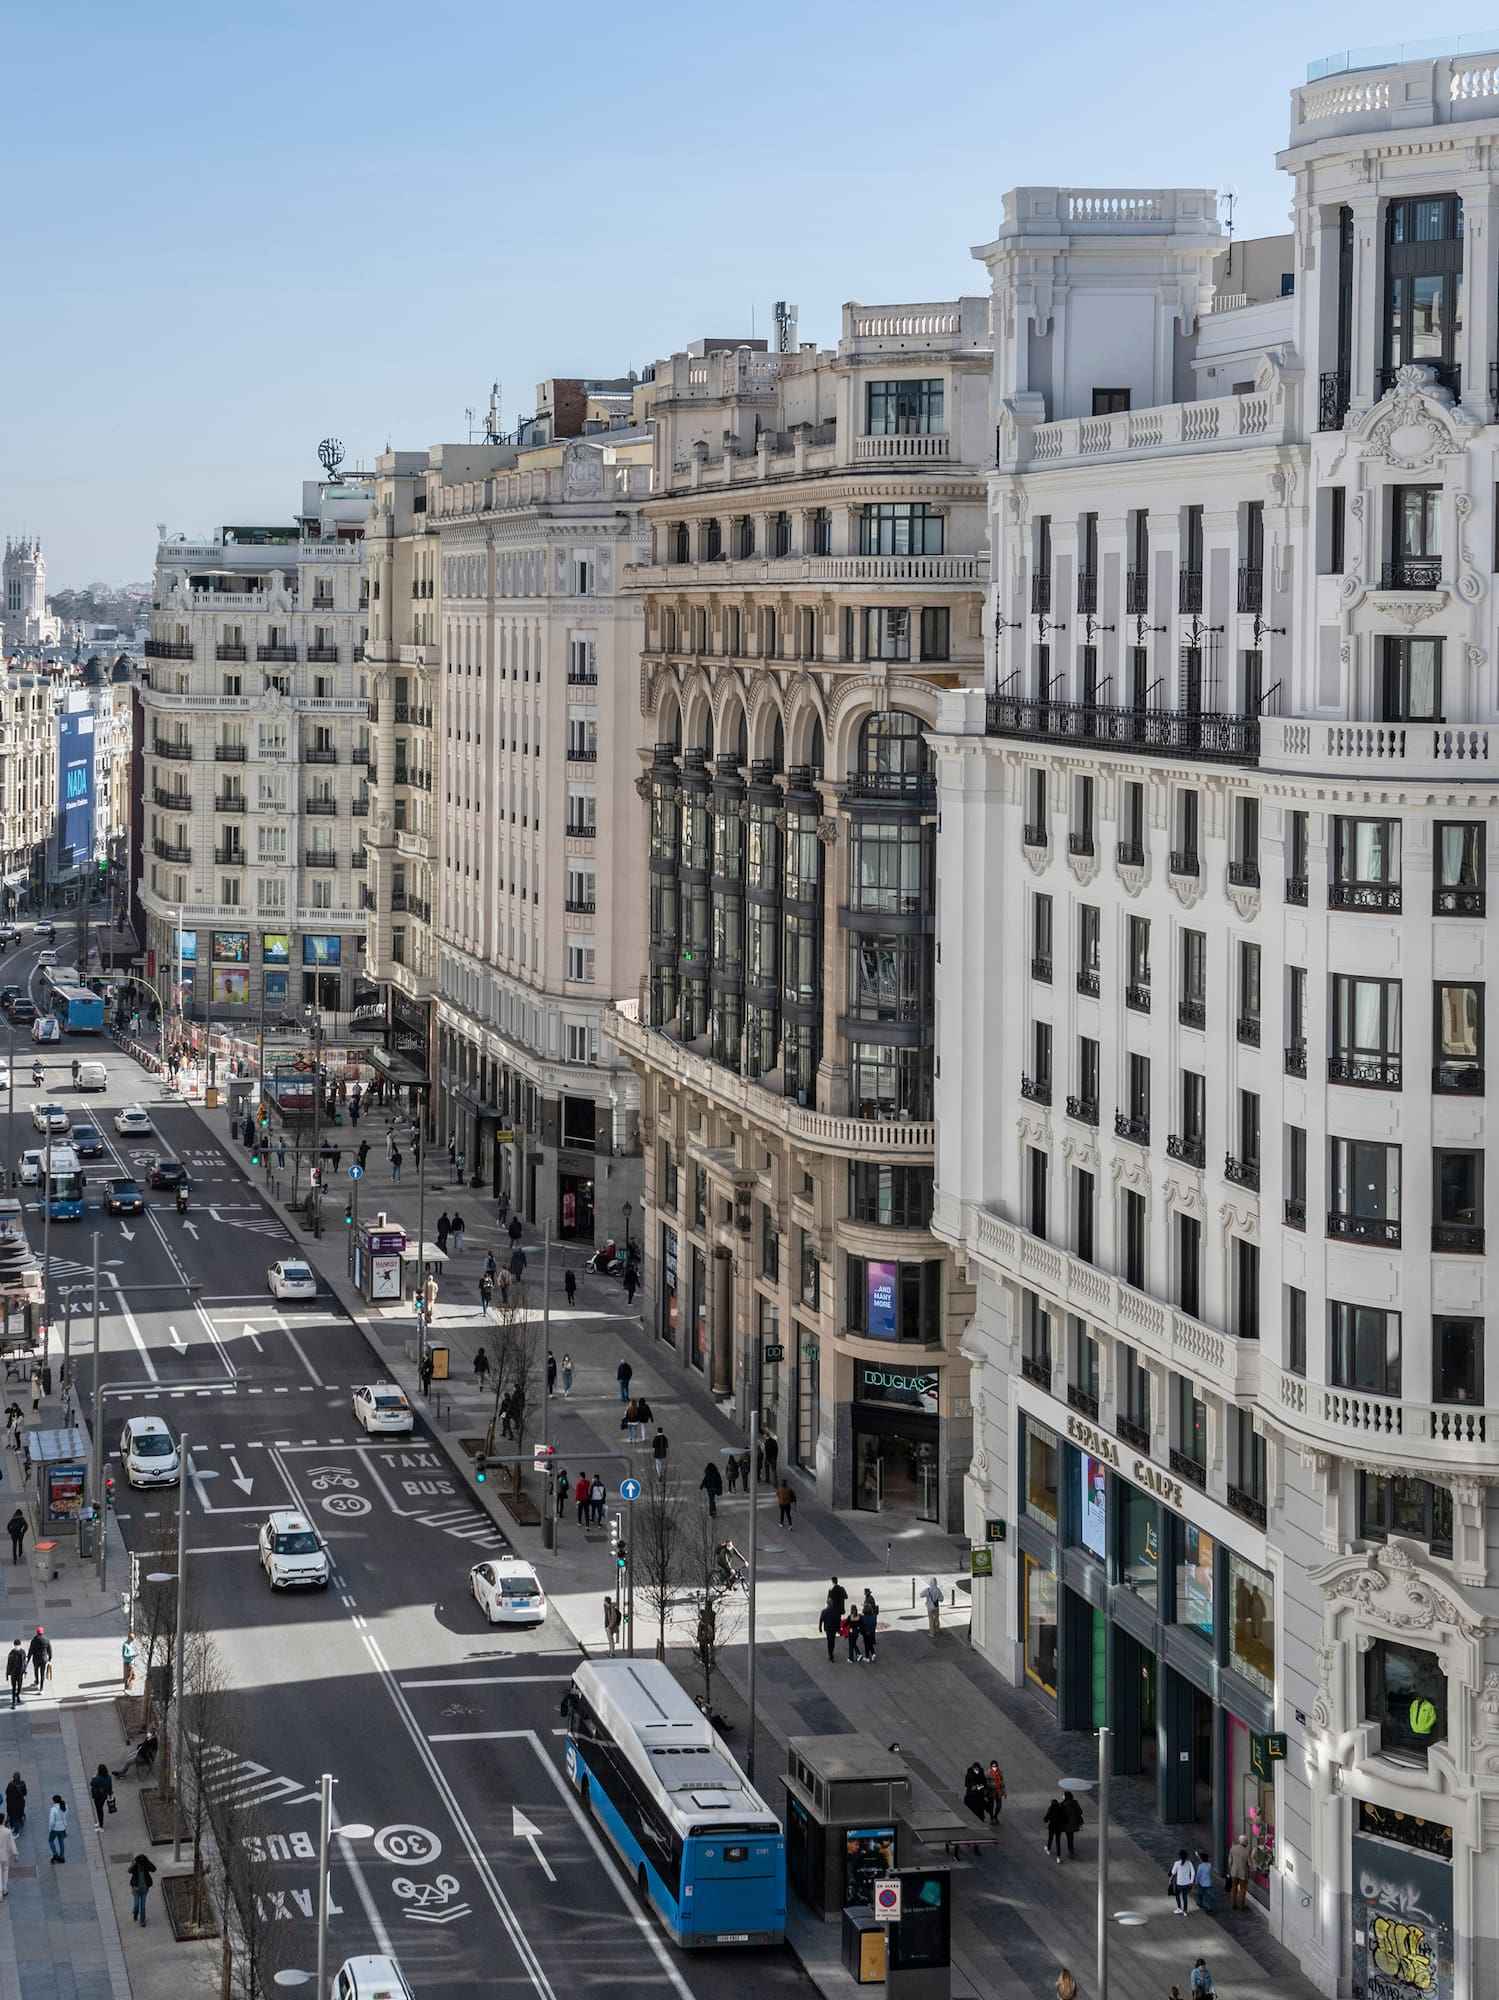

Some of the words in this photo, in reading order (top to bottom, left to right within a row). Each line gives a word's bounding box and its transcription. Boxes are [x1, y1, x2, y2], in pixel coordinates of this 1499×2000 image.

[67, 768, 87, 798] NADA
[182, 1149, 222, 1157] TAXI
[191, 1159, 226, 1167] BUS
[874, 1292, 892, 1301] MANY
[864, 1370, 926, 1393] DOUGLAS
[380, 1453, 441, 1468] TAXI
[1066, 1415, 1120, 1468] ESPASA
[1133, 1459, 1183, 1508] CALPE
[401, 1480, 456, 1495] BUS
[333, 1499, 360, 1511] 30
[241, 1831, 316, 1862] BUS
[389, 1835, 427, 1856] 30
[252, 1888, 344, 1922] TAXI
